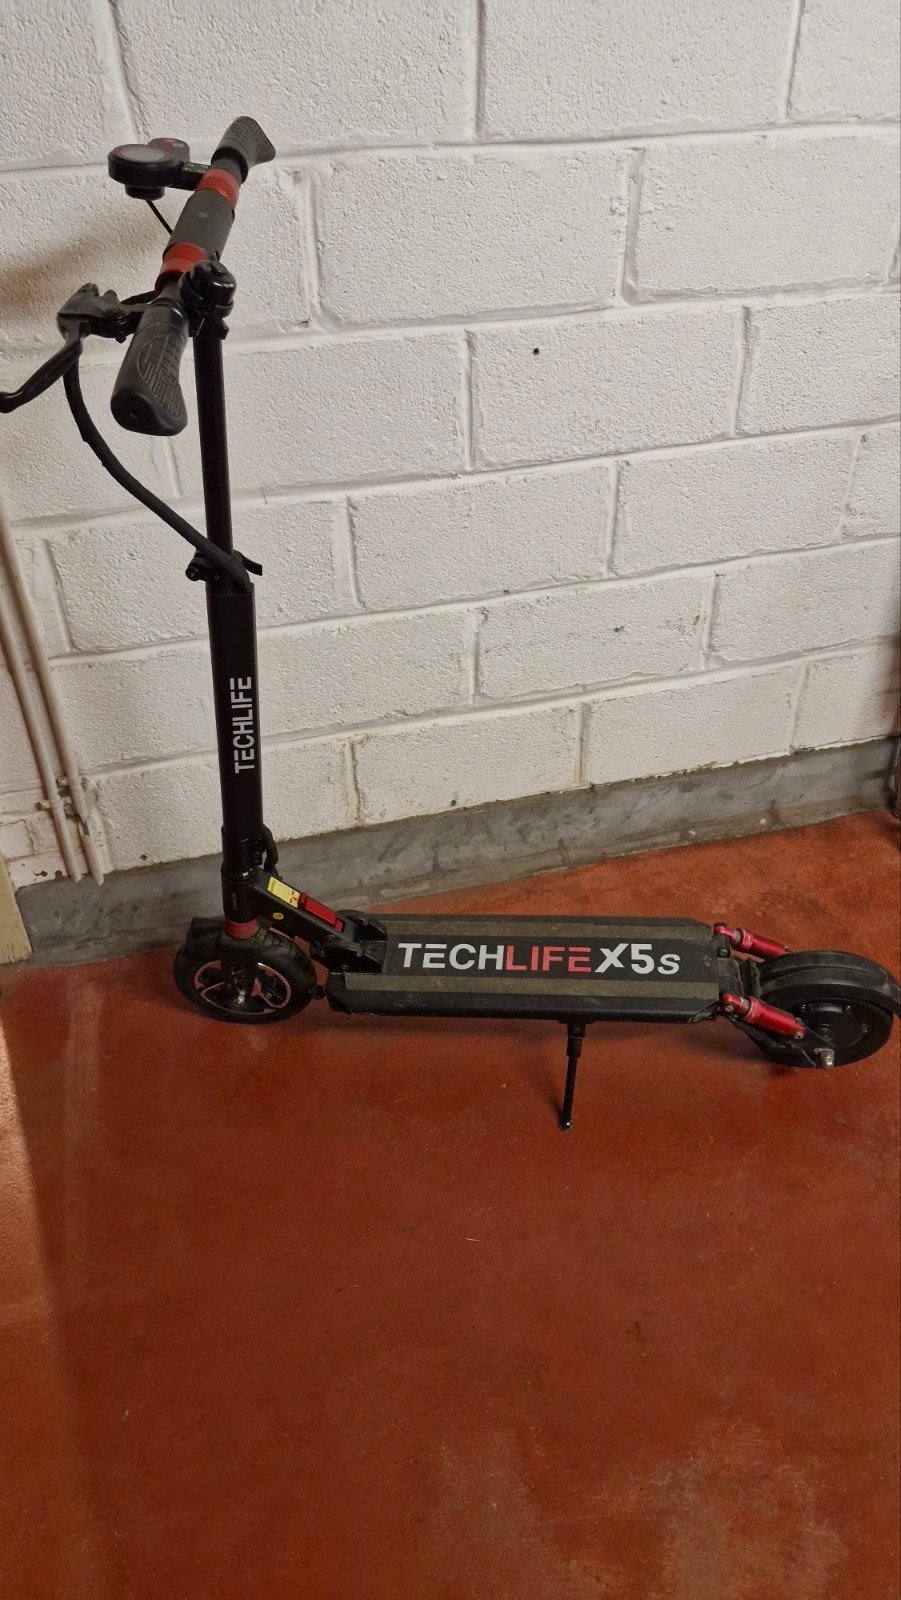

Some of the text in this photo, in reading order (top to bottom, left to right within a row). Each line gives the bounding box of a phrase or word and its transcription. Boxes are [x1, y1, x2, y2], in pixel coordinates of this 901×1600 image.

[229, 676, 255, 774] TECHLIFE
[398, 942, 681, 975] TECHLIFE X5s
